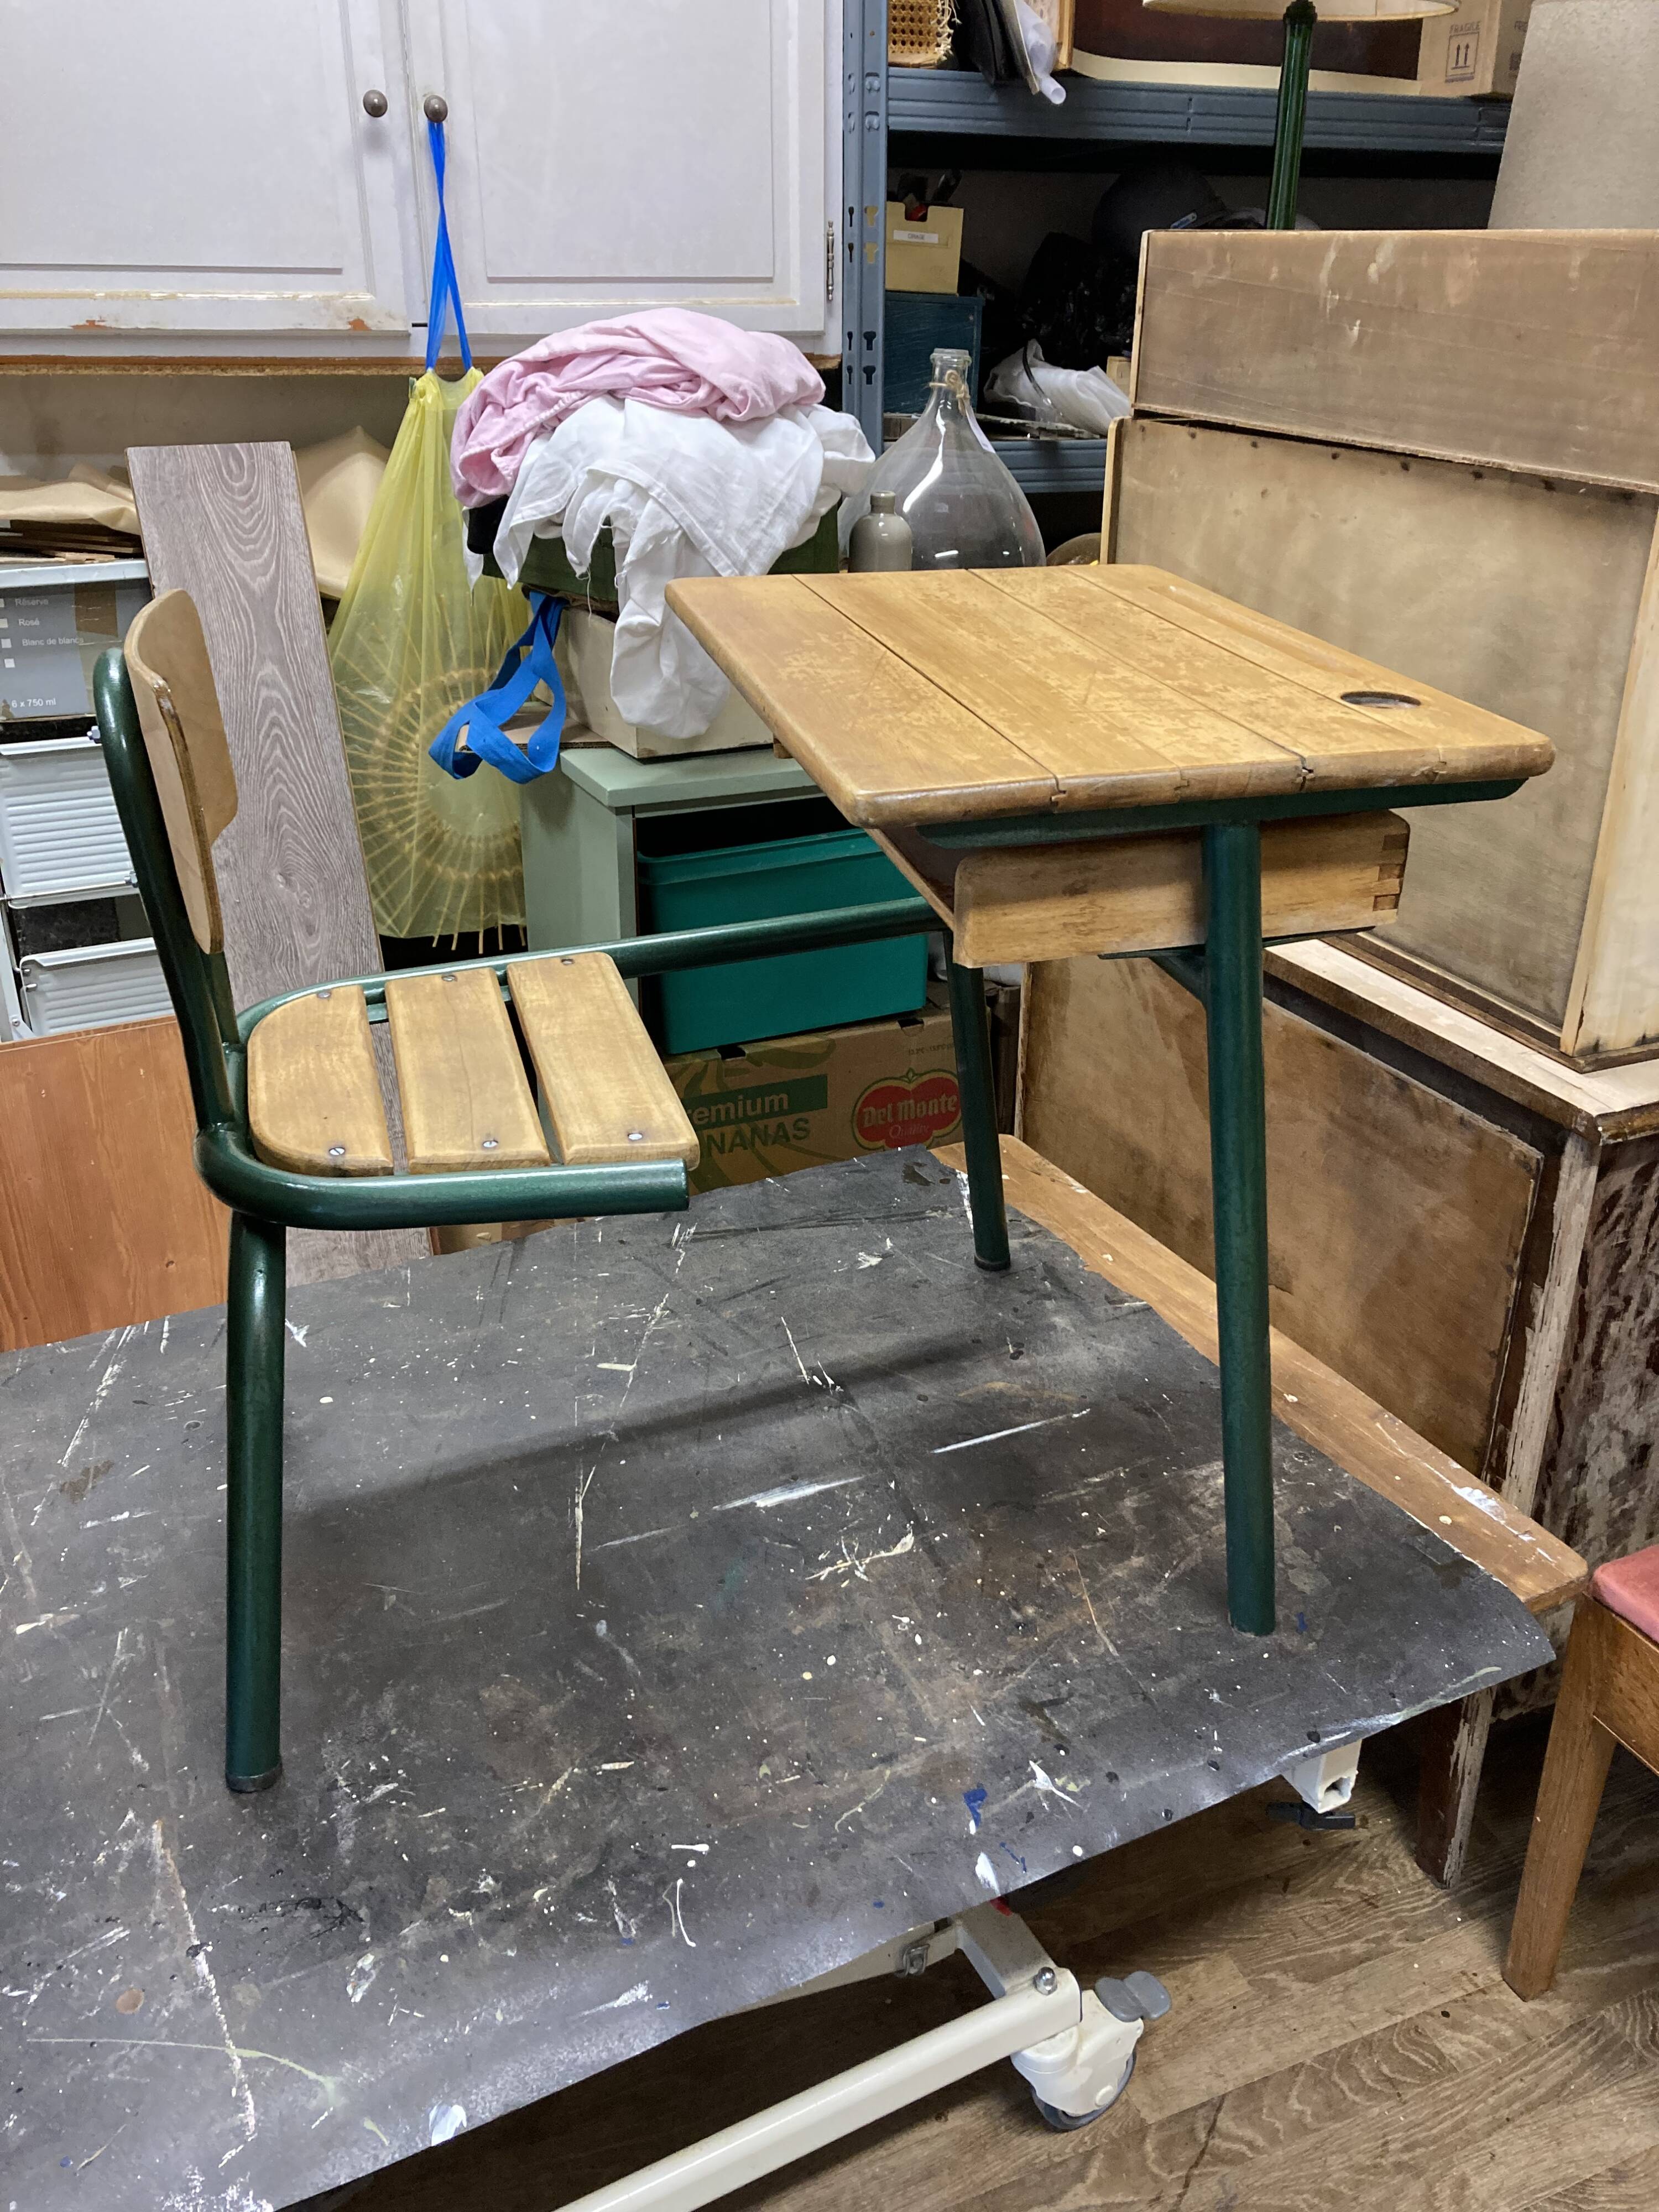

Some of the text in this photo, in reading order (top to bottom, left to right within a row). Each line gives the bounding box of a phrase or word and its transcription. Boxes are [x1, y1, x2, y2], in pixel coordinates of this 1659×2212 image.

[1449, 21, 1481, 34] FRAGILE
[18, 618, 40, 626] Rosé
[22, 638, 45, 646] Blanc
[27, 698, 44, 707] 750
[686, 1093, 789, 1125] emium
[863, 1093, 957, 1128] Del Monte
[706, 1118, 810, 1156] NANAS
